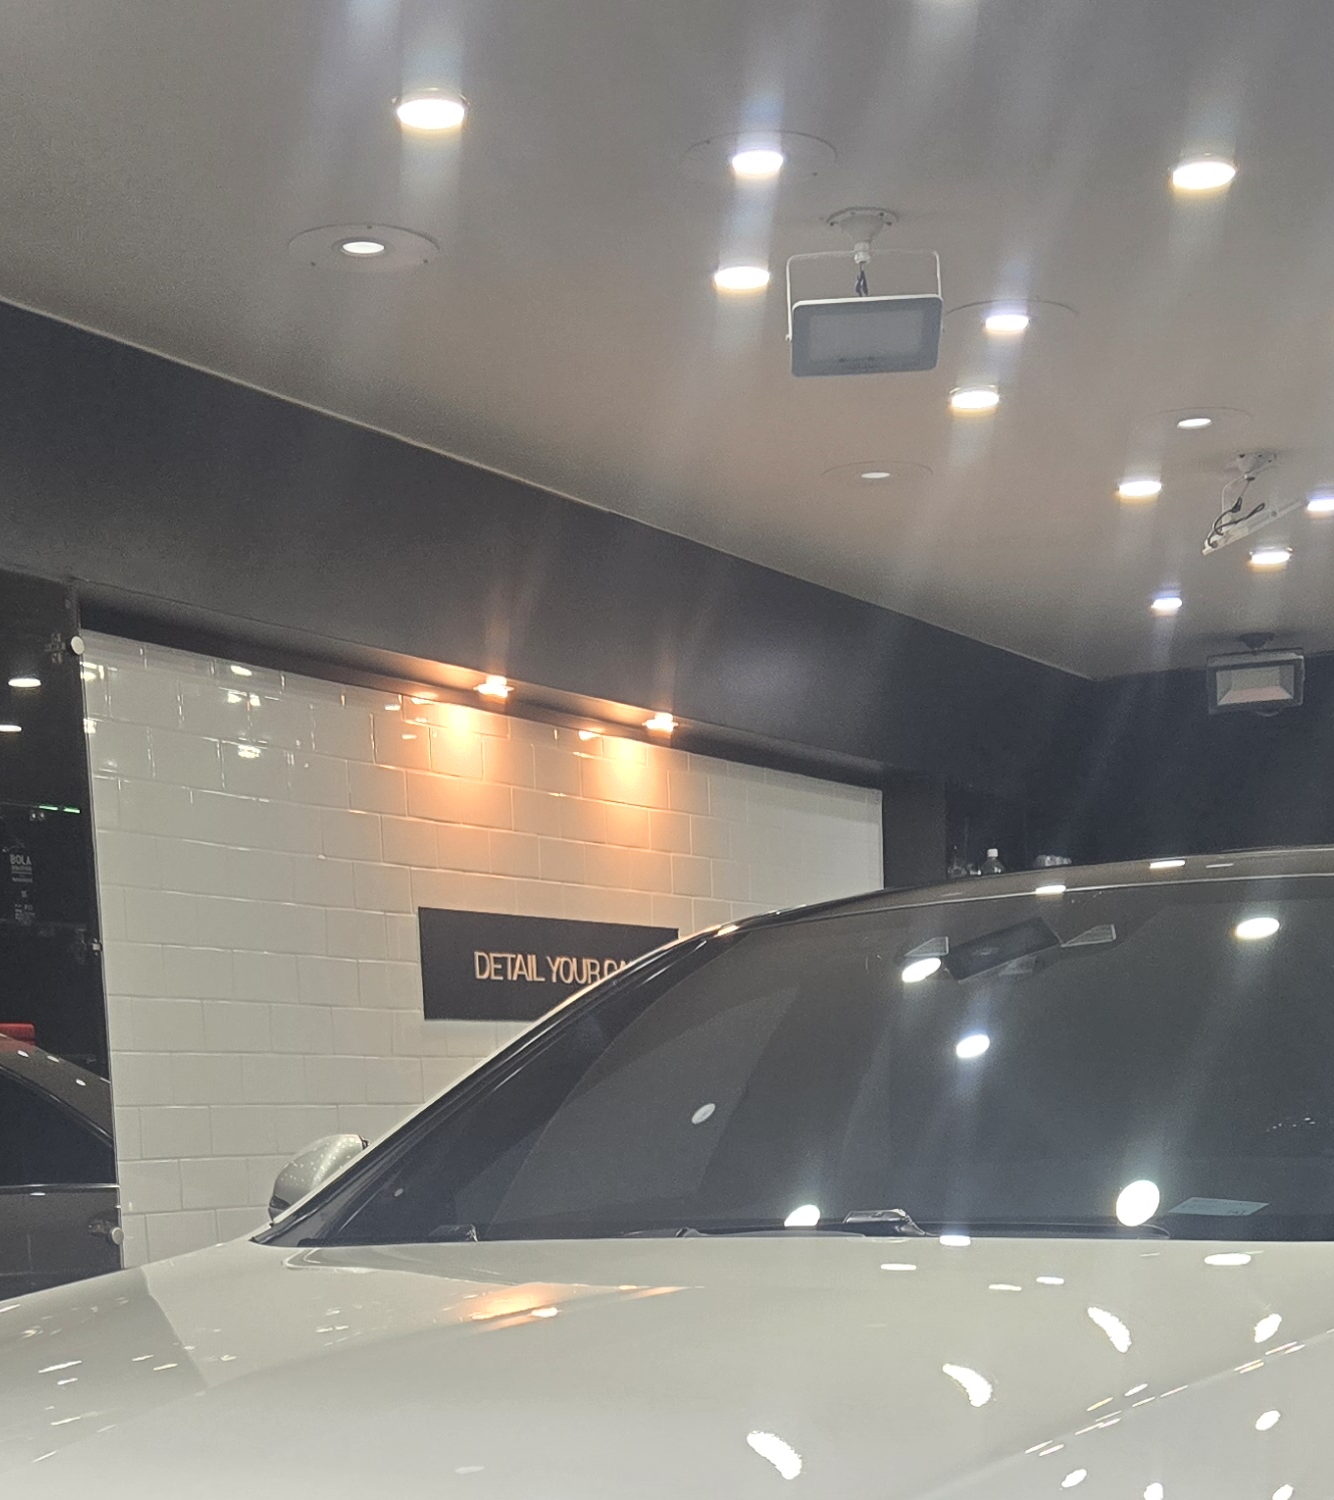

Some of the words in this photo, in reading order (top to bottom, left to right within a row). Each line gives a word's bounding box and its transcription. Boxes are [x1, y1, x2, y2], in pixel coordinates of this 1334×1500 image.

[10, 854, 32, 866] BOLA
[474, 951, 545, 982] DETAIL
[547, 956, 600, 984] YOUR
